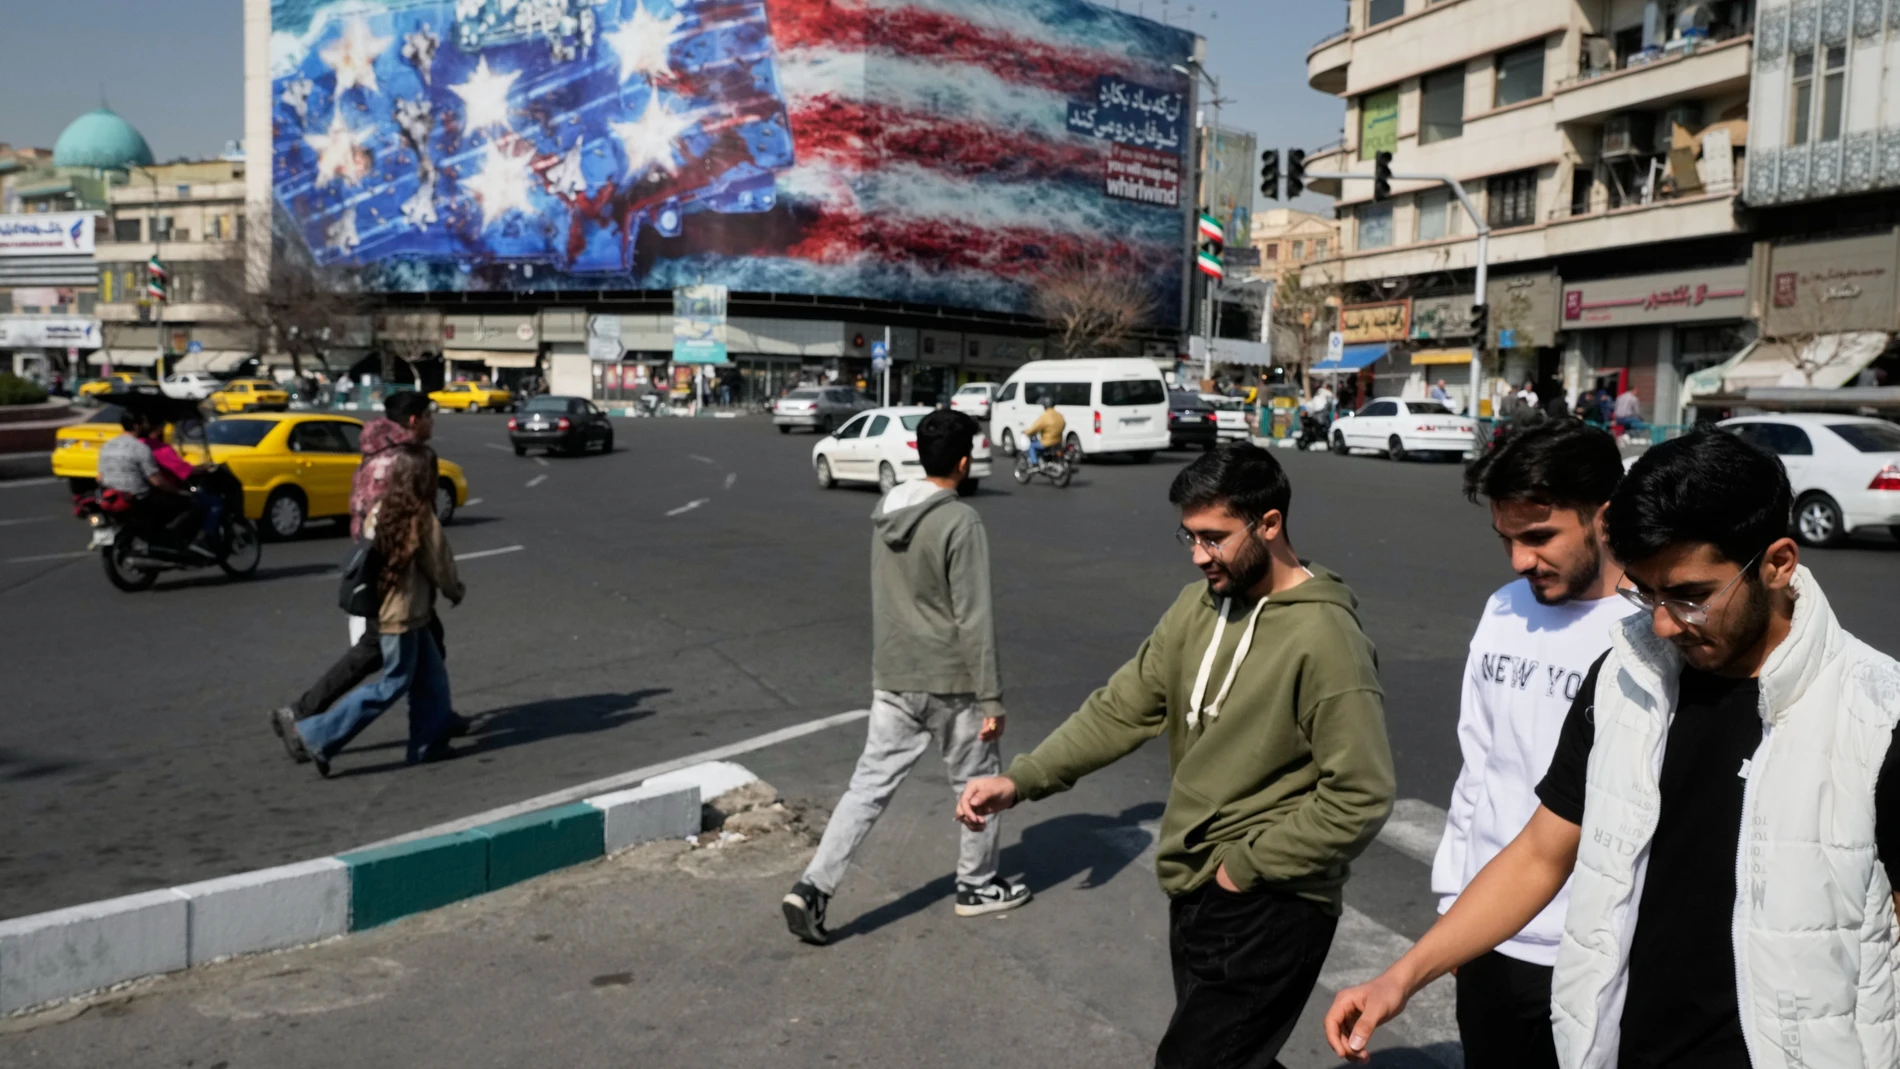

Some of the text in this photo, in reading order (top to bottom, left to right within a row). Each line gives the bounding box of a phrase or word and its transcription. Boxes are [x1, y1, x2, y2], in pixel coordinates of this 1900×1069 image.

[1099, 82, 1130, 112] بکارد
[1132, 88, 1152, 117] باد
[1106, 174, 1178, 205] whirlwind
[1481, 653, 1539, 690] NEW
